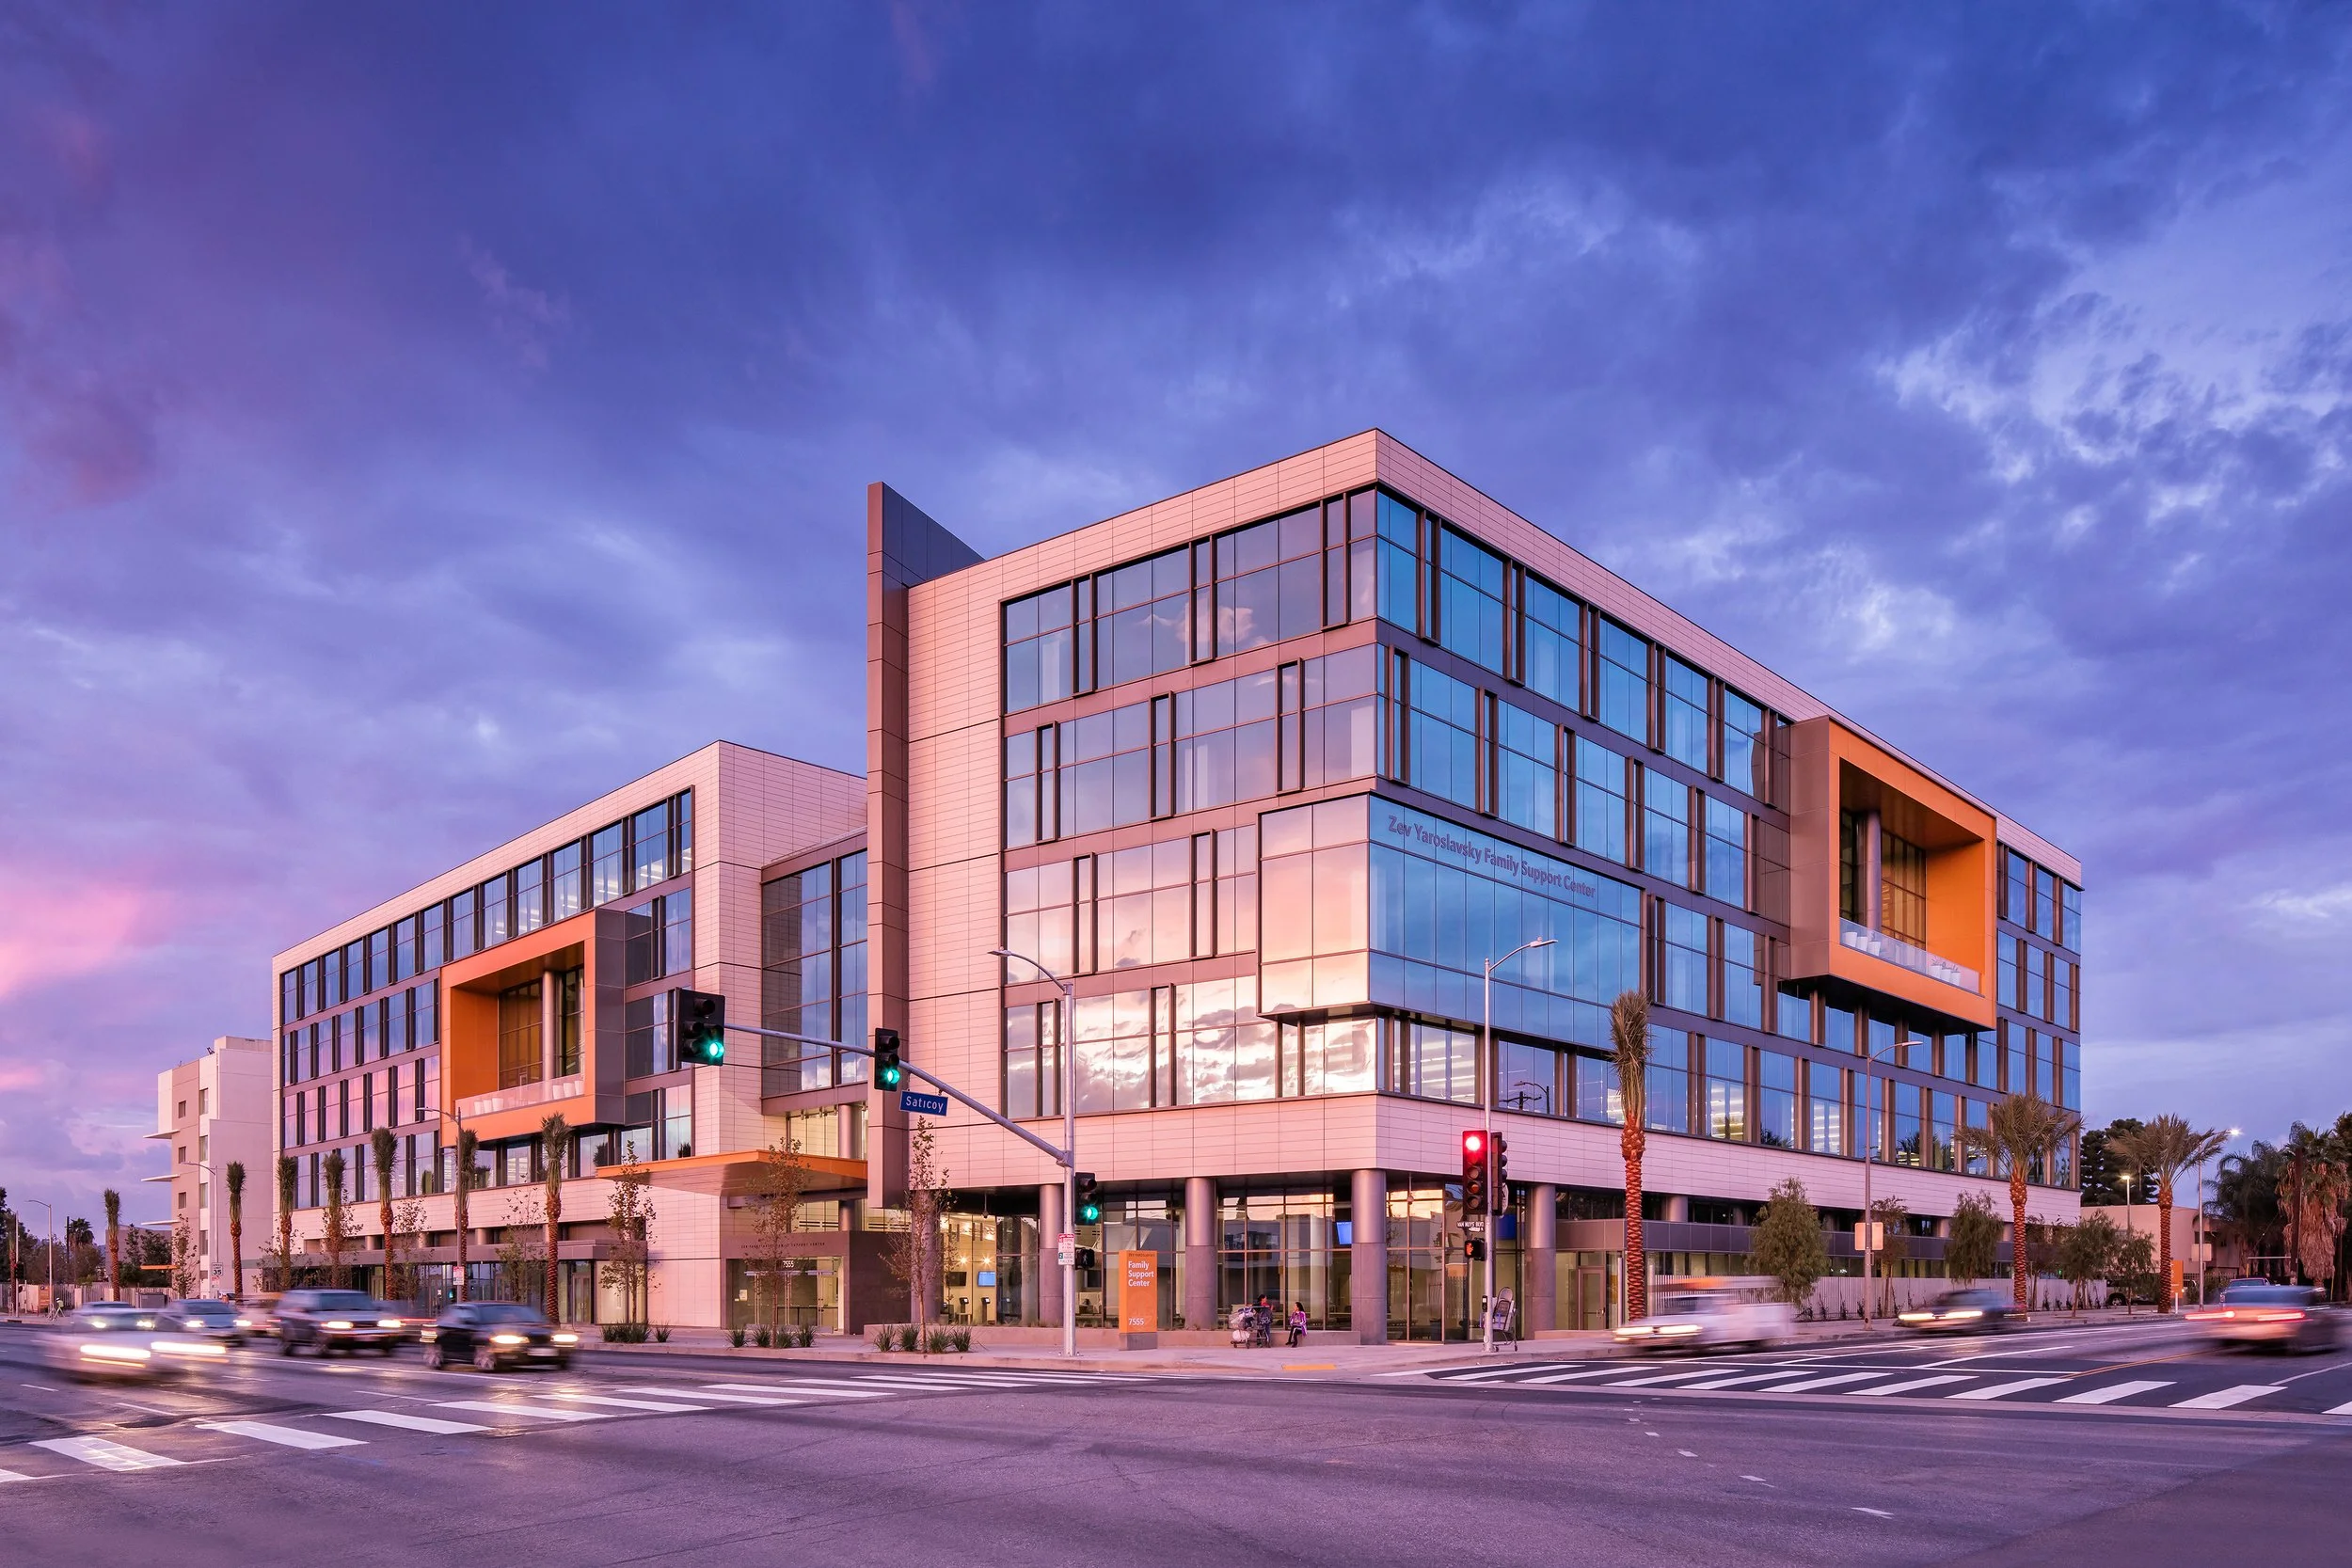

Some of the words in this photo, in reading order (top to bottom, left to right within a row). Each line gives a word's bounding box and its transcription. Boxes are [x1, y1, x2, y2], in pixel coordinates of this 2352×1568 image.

[1389, 815, 1411, 836] Zev
[1414, 823, 1482, 864] Yaroslavsky
[1485, 847, 1519, 877] Family
[1521, 861, 1562, 886] Support
[1564, 875, 1596, 897] Center
[906, 1096, 944, 1113] Saticoy
[1128, 1260, 1149, 1270] Family
[1128, 1270, 1153, 1279] Support
